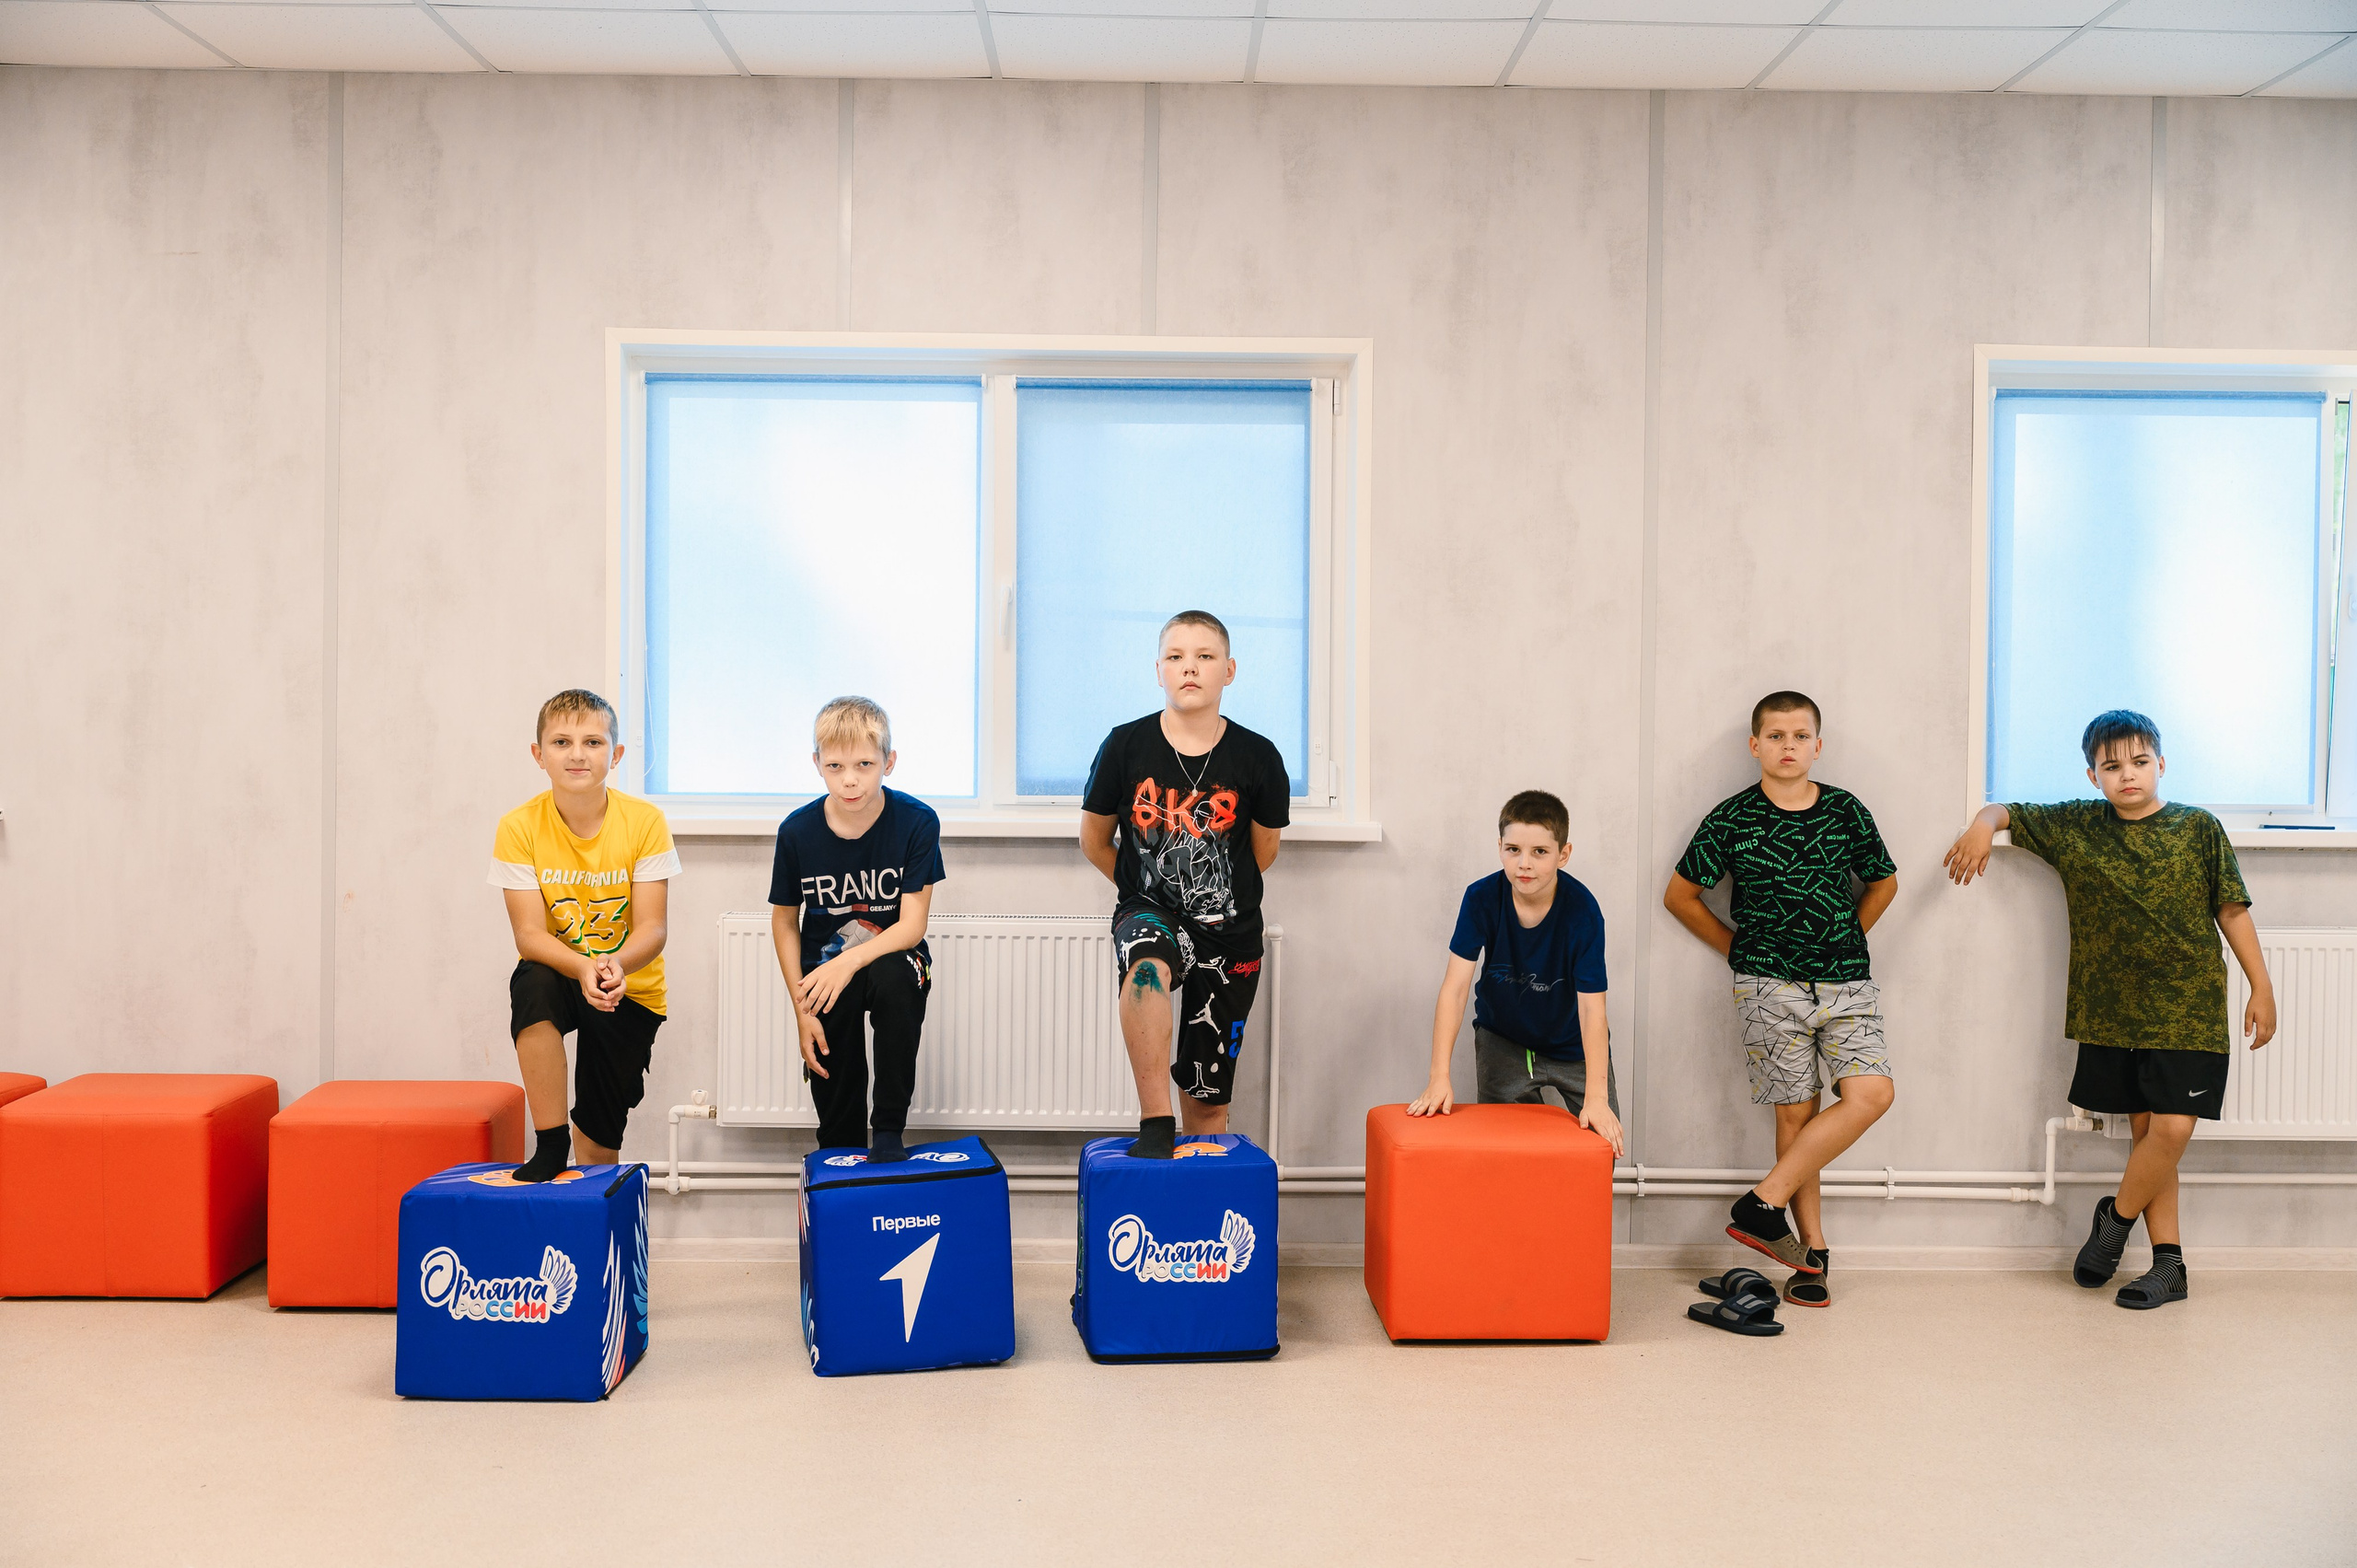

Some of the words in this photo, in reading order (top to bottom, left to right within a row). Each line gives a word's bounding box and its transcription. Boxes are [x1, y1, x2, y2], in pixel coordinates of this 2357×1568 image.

[540, 867, 629, 889] CALIFORNIA
[550, 895, 630, 958] 23
[872, 1214, 941, 1234] Первые
[1110, 1218, 1229, 1277] Орлята
[424, 1249, 549, 1309] Орлята
